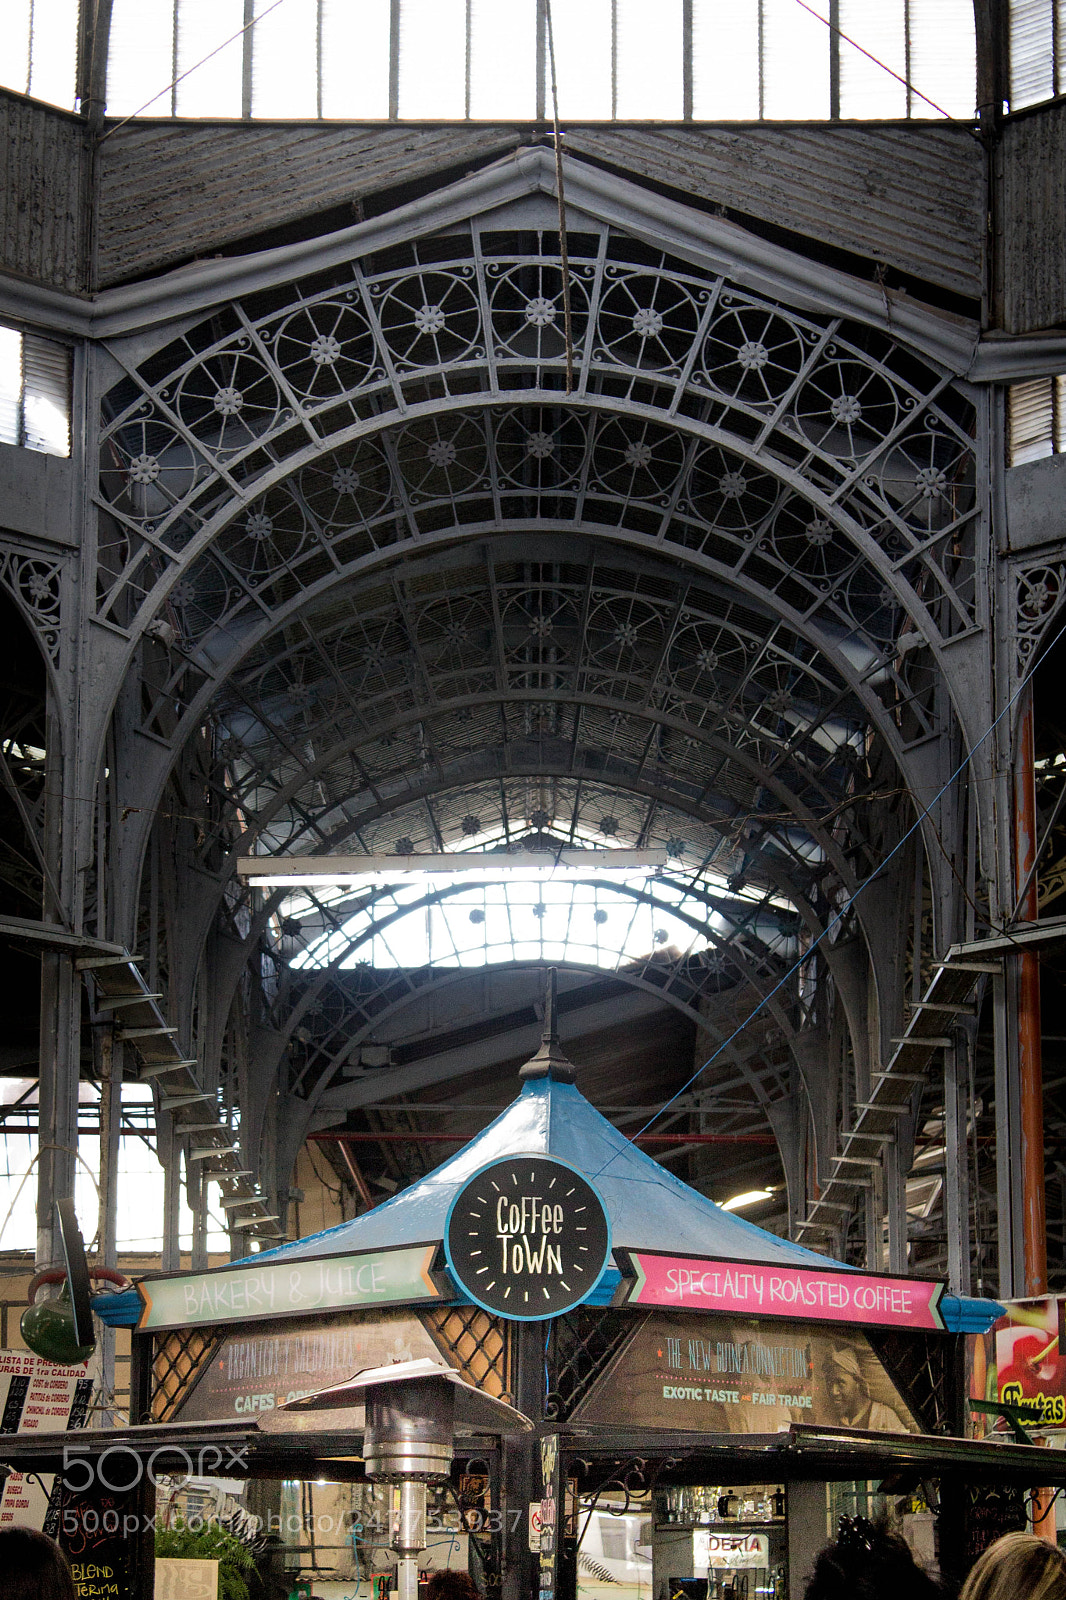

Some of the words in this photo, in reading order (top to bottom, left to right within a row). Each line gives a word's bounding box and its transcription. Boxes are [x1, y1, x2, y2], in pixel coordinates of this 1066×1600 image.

[184, 1271, 276, 1316] BAKERY
[289, 1271, 308, 1305] &
[313, 1262, 386, 1306] JUICE
[664, 1268, 764, 1305] SPECIALTY
[769, 1276, 850, 1308] ROASTED
[853, 1285, 912, 1314] COFFEE
[0, 1355, 21, 1365] LISTA
[23, 1357, 35, 1366] DE
[665, 1337, 684, 1369] THE
[688, 1339, 711, 1371] NEW
[716, 1341, 749, 1374] GUINEA
[750, 1344, 808, 1378] CONNECTION
[22, 1367, 34, 1375] DE
[37, 1368, 49, 1376] 1ra
[51, 1369, 86, 1378] CALIDAD
[234, 1393, 275, 1414] CAFES
[663, 1385, 703, 1401] EXOTIC
[704, 1388, 740, 1404] TASTE
[752, 1392, 777, 1406] FAIR
[778, 1394, 813, 1409] TRADE
